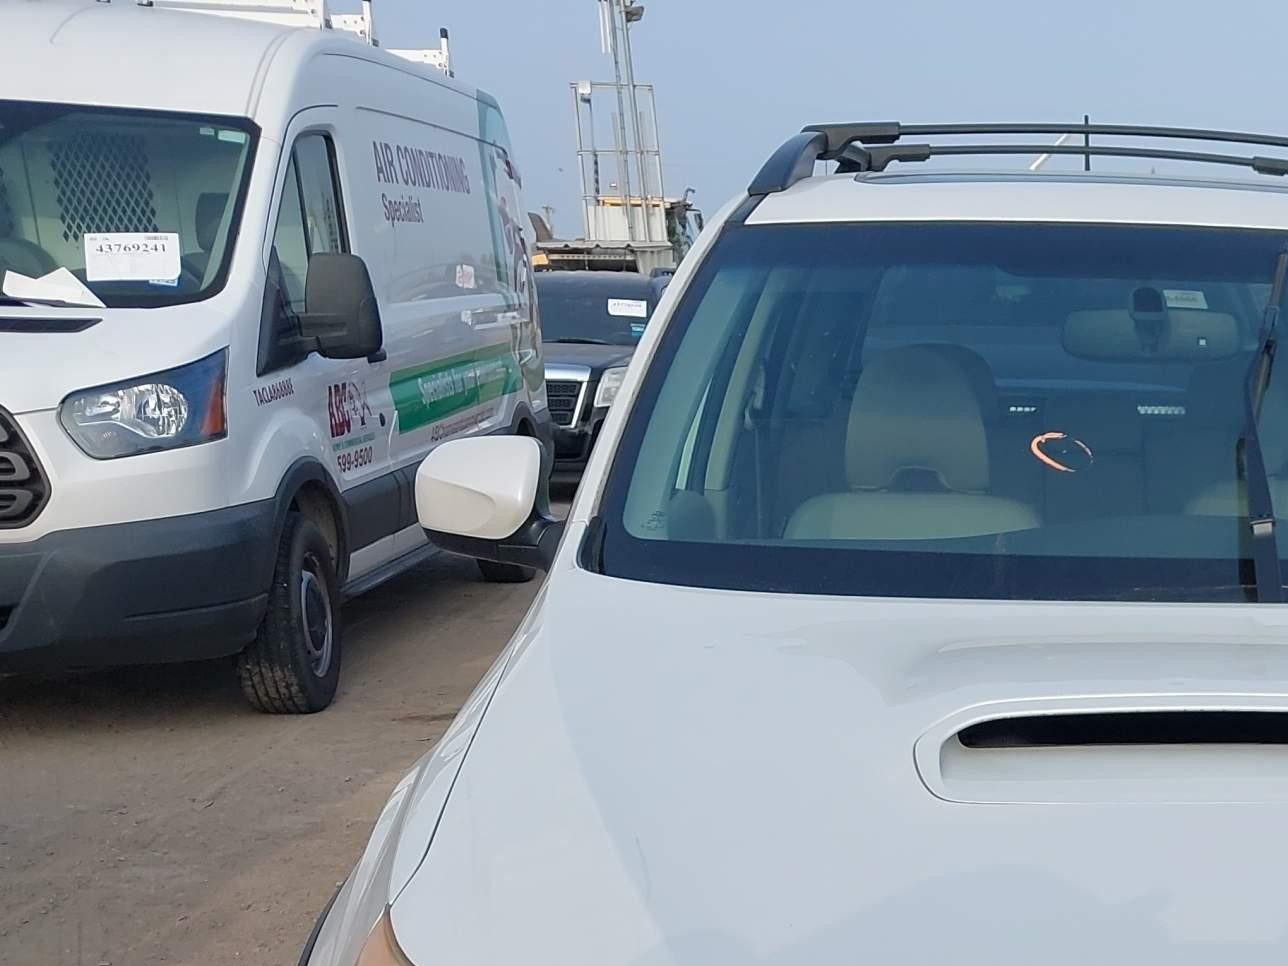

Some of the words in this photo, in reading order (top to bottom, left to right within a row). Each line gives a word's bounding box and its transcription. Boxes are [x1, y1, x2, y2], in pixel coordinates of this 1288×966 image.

[373, 140, 399, 184] AIR
[396, 144, 471, 194] CONDITIONING
[381, 192, 424, 227] Specialist
[96, 243, 167, 253] 43769241
[328, 382, 352, 438] ABC
[337, 446, 373, 473] 599-9500
